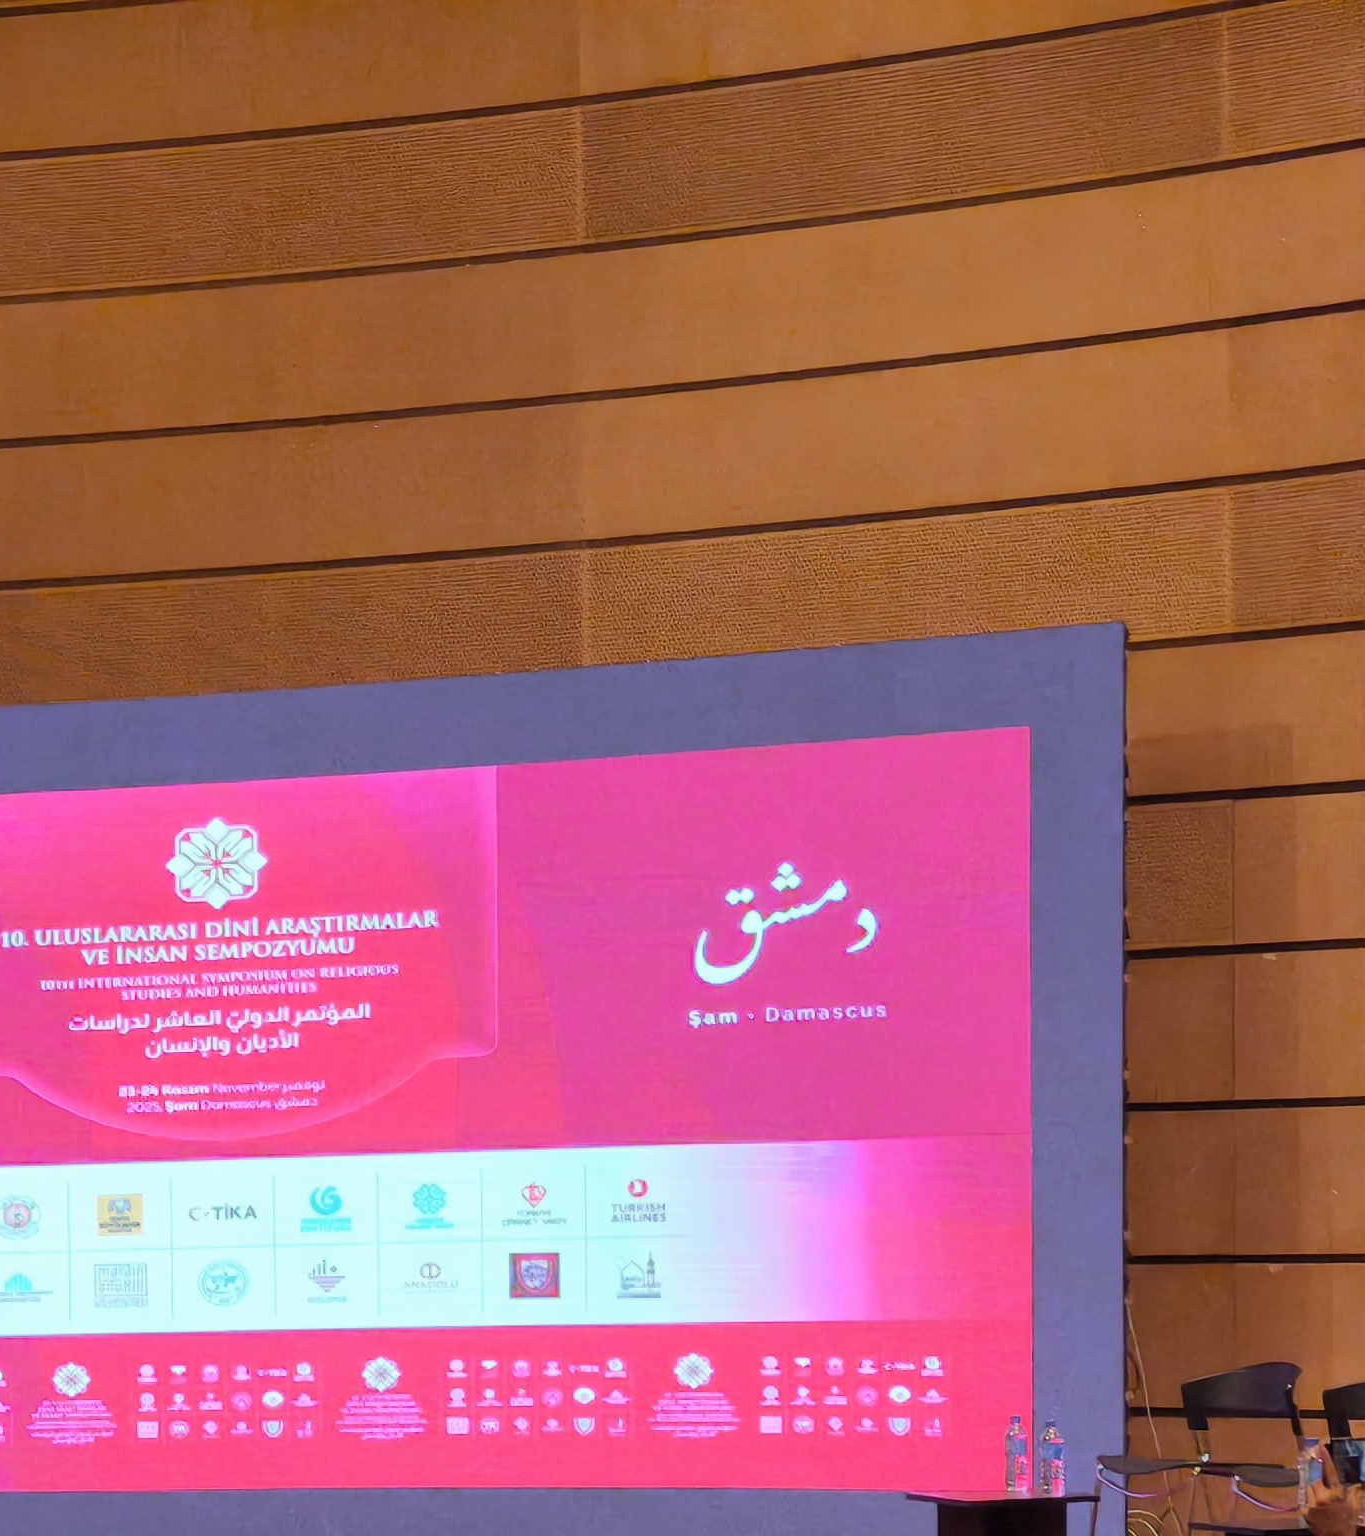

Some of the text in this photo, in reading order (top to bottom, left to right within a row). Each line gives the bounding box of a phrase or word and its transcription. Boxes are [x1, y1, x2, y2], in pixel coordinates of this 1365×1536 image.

[34, 923, 197, 946] ULUSLARARASI
[205, 916, 259, 939] DİNİ
[265, 910, 439, 938] ARAŞTIRMALAR
[694, 861, 878, 985] دمشق
[81, 937, 355, 966] VE İNSAN SEMPOZYUMU
[78, 972, 197, 990] INTERNATIONAL
[291, 967, 316, 980] ON
[320, 964, 400, 978] RELIGIOUS
[185, 985, 219, 998] AND
[68, 1013, 150, 1035] لدراسات
[152, 1009, 221, 1033] العاشر
[292, 1003, 371, 1027] المؤتمر
[688, 1005, 887, 1029] Şam Damascus
